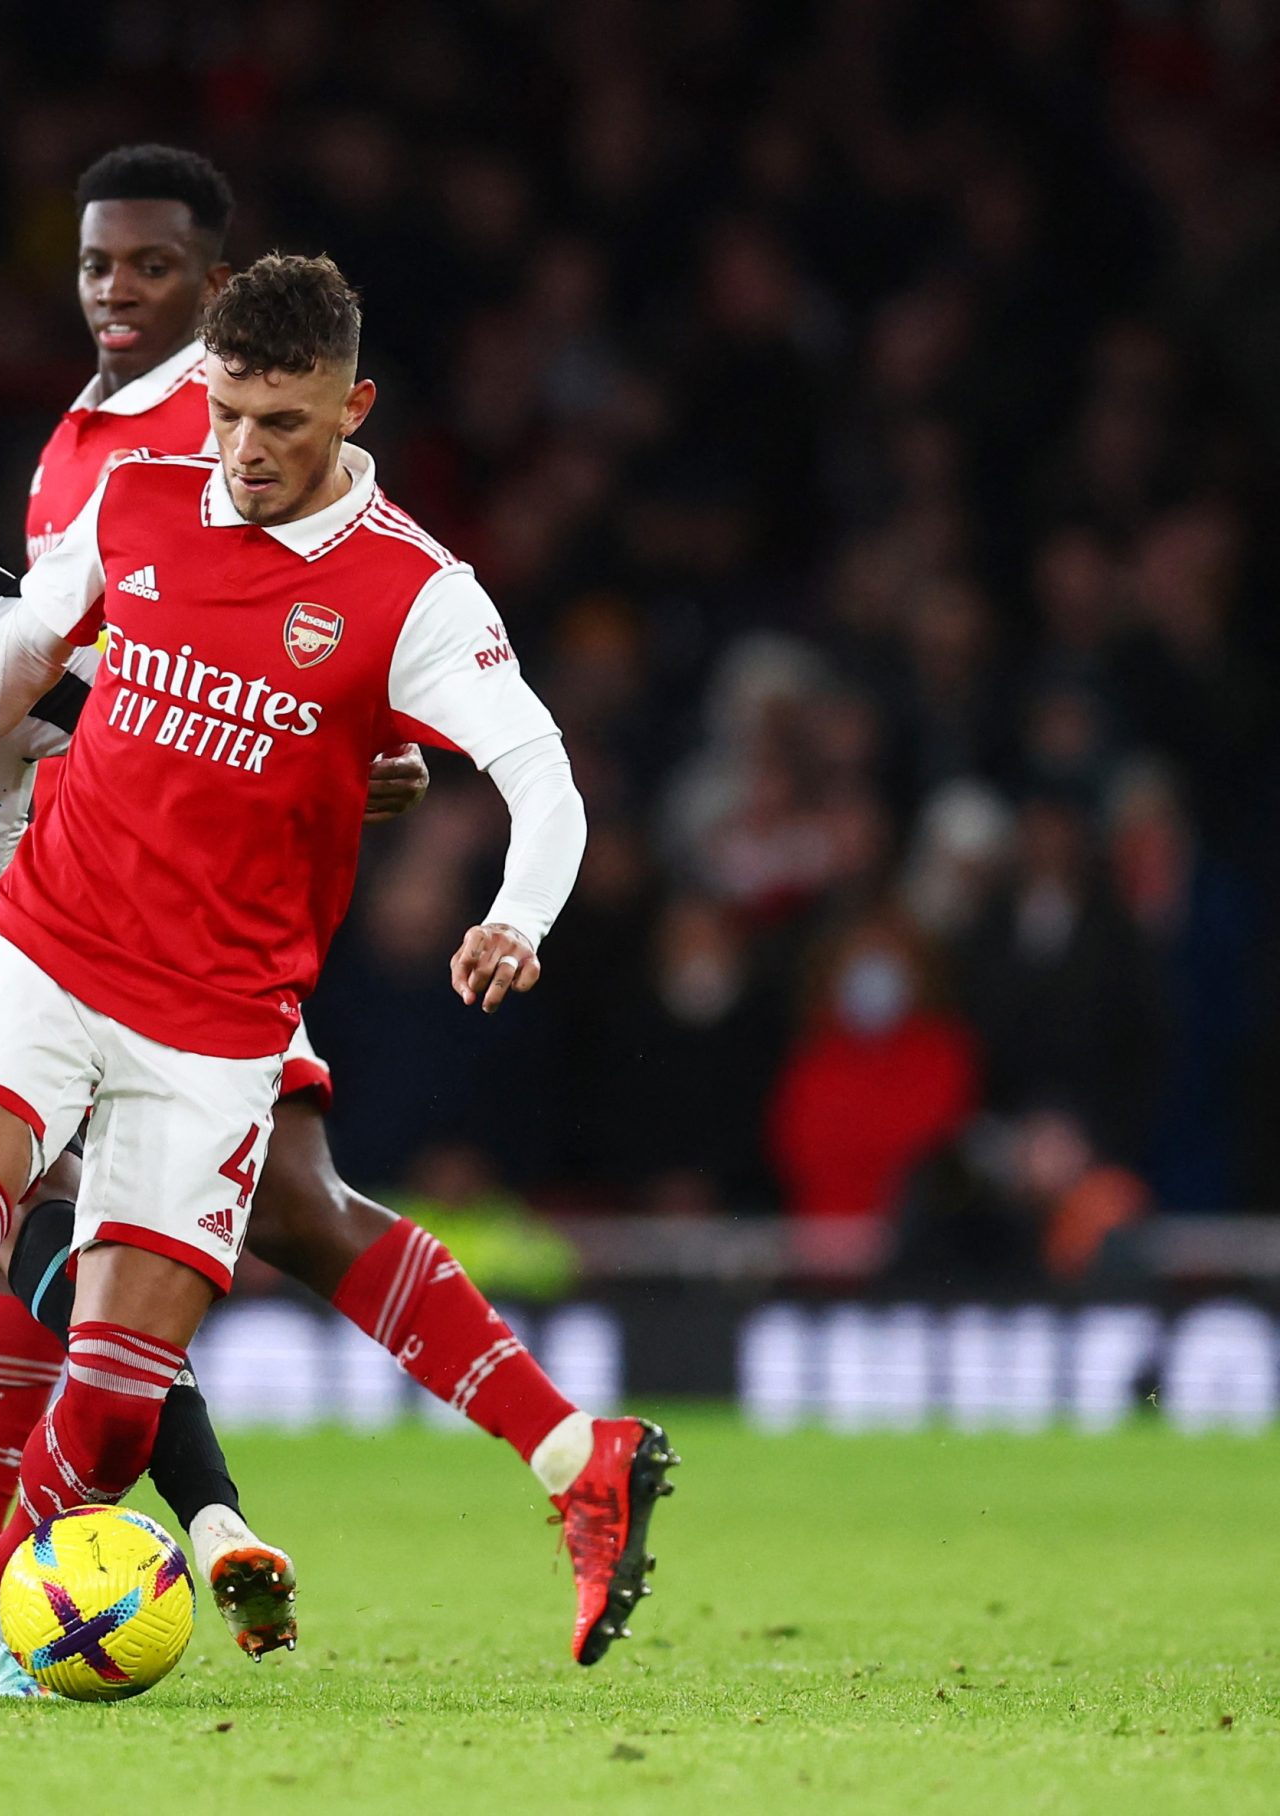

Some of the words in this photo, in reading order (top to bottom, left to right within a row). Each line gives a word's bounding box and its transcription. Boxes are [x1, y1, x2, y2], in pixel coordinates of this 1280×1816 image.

[118, 580, 160, 602] adidas
[295, 610, 337, 632] Arsenal
[106, 622, 322, 736] Emirates
[108, 688, 157, 736] FLY
[155, 706, 273, 774] BETTER
[218, 1122, 260, 1209] 4
[197, 1216, 234, 1247] adidas
